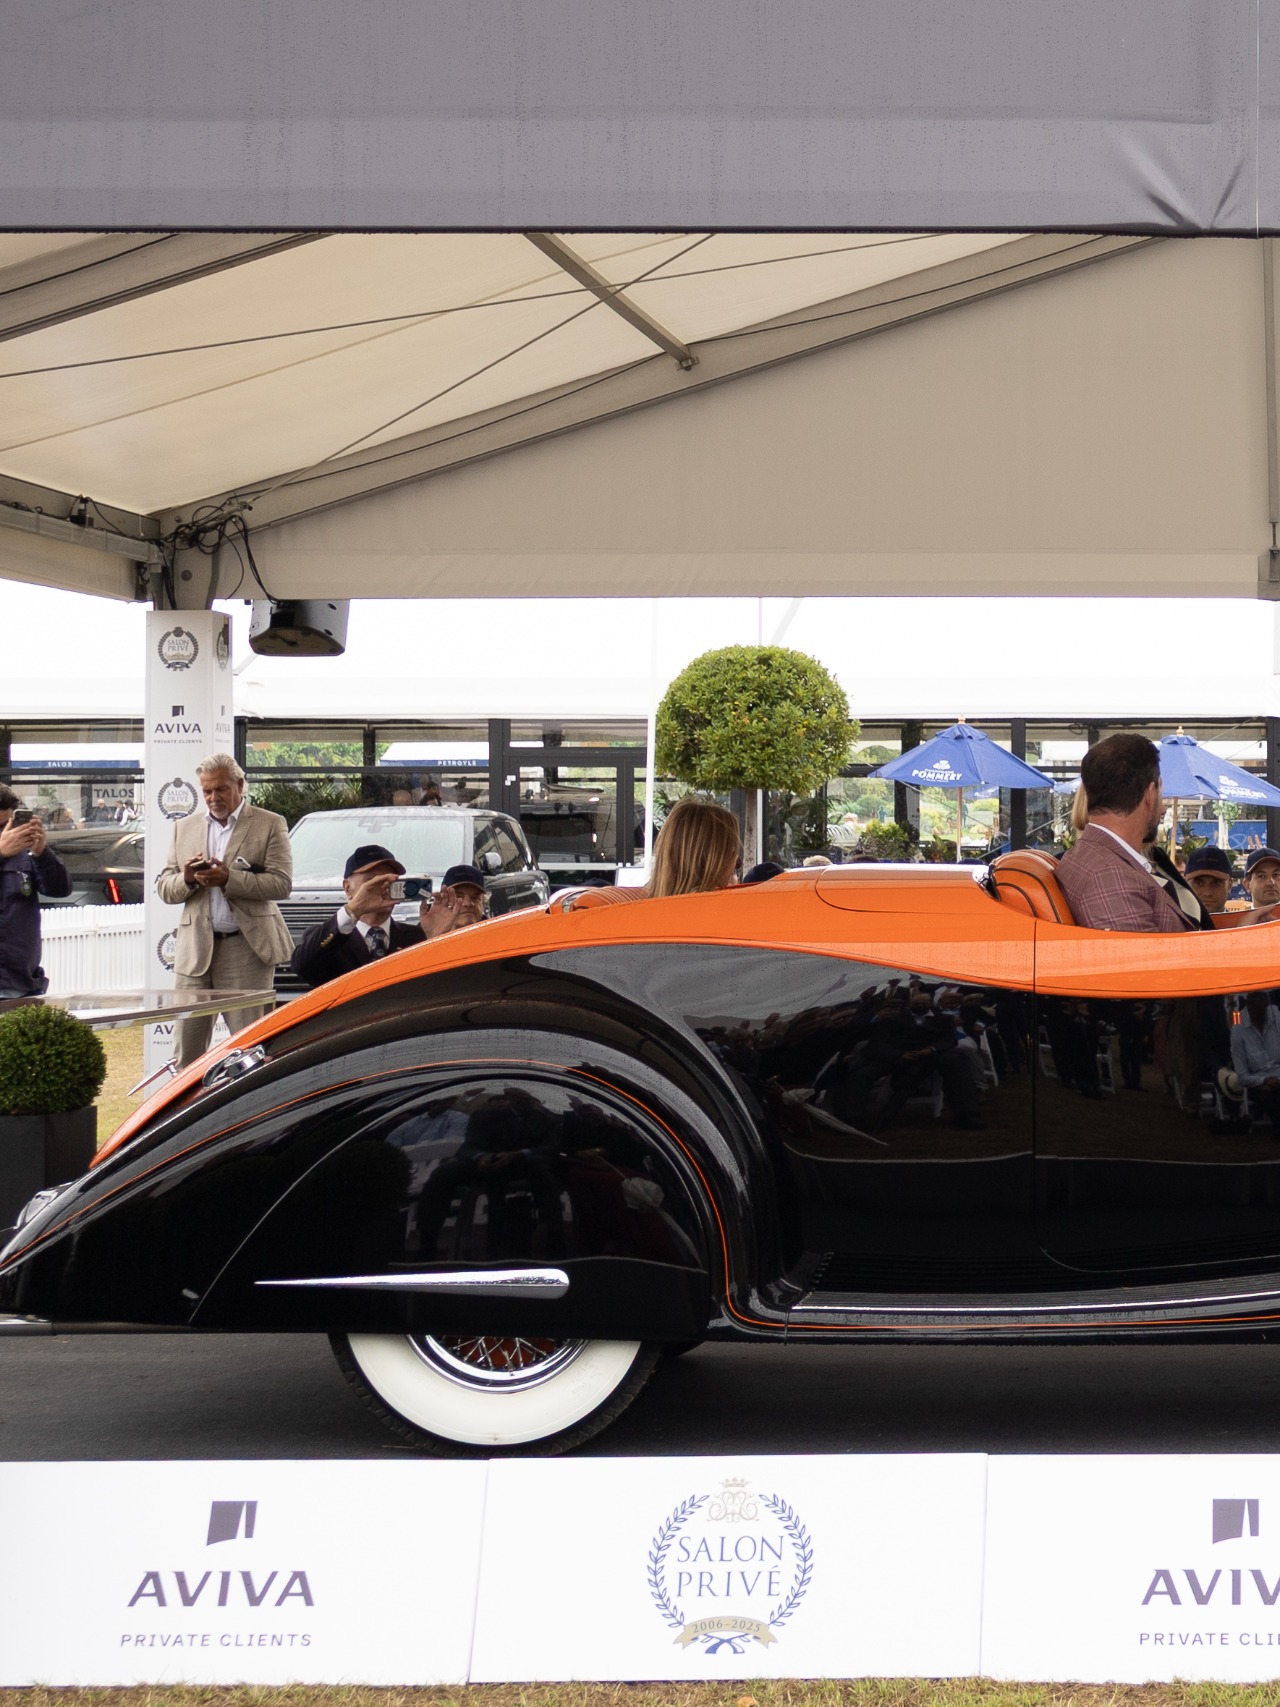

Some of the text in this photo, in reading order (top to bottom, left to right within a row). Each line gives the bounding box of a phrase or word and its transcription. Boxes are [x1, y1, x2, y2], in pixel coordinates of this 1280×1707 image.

[154, 723, 202, 733] AVIVA
[911, 769, 963, 781] POMMERY
[93, 788, 134, 798] TALOS
[677, 1535, 784, 1563] SALON
[676, 1565, 781, 1597] PRIVÉ
[127, 1570, 315, 1607] AVIVA
[120, 1634, 312, 1647] PRIVATE CLIENTS
[1139, 1633, 1230, 1646] PRIVATE
